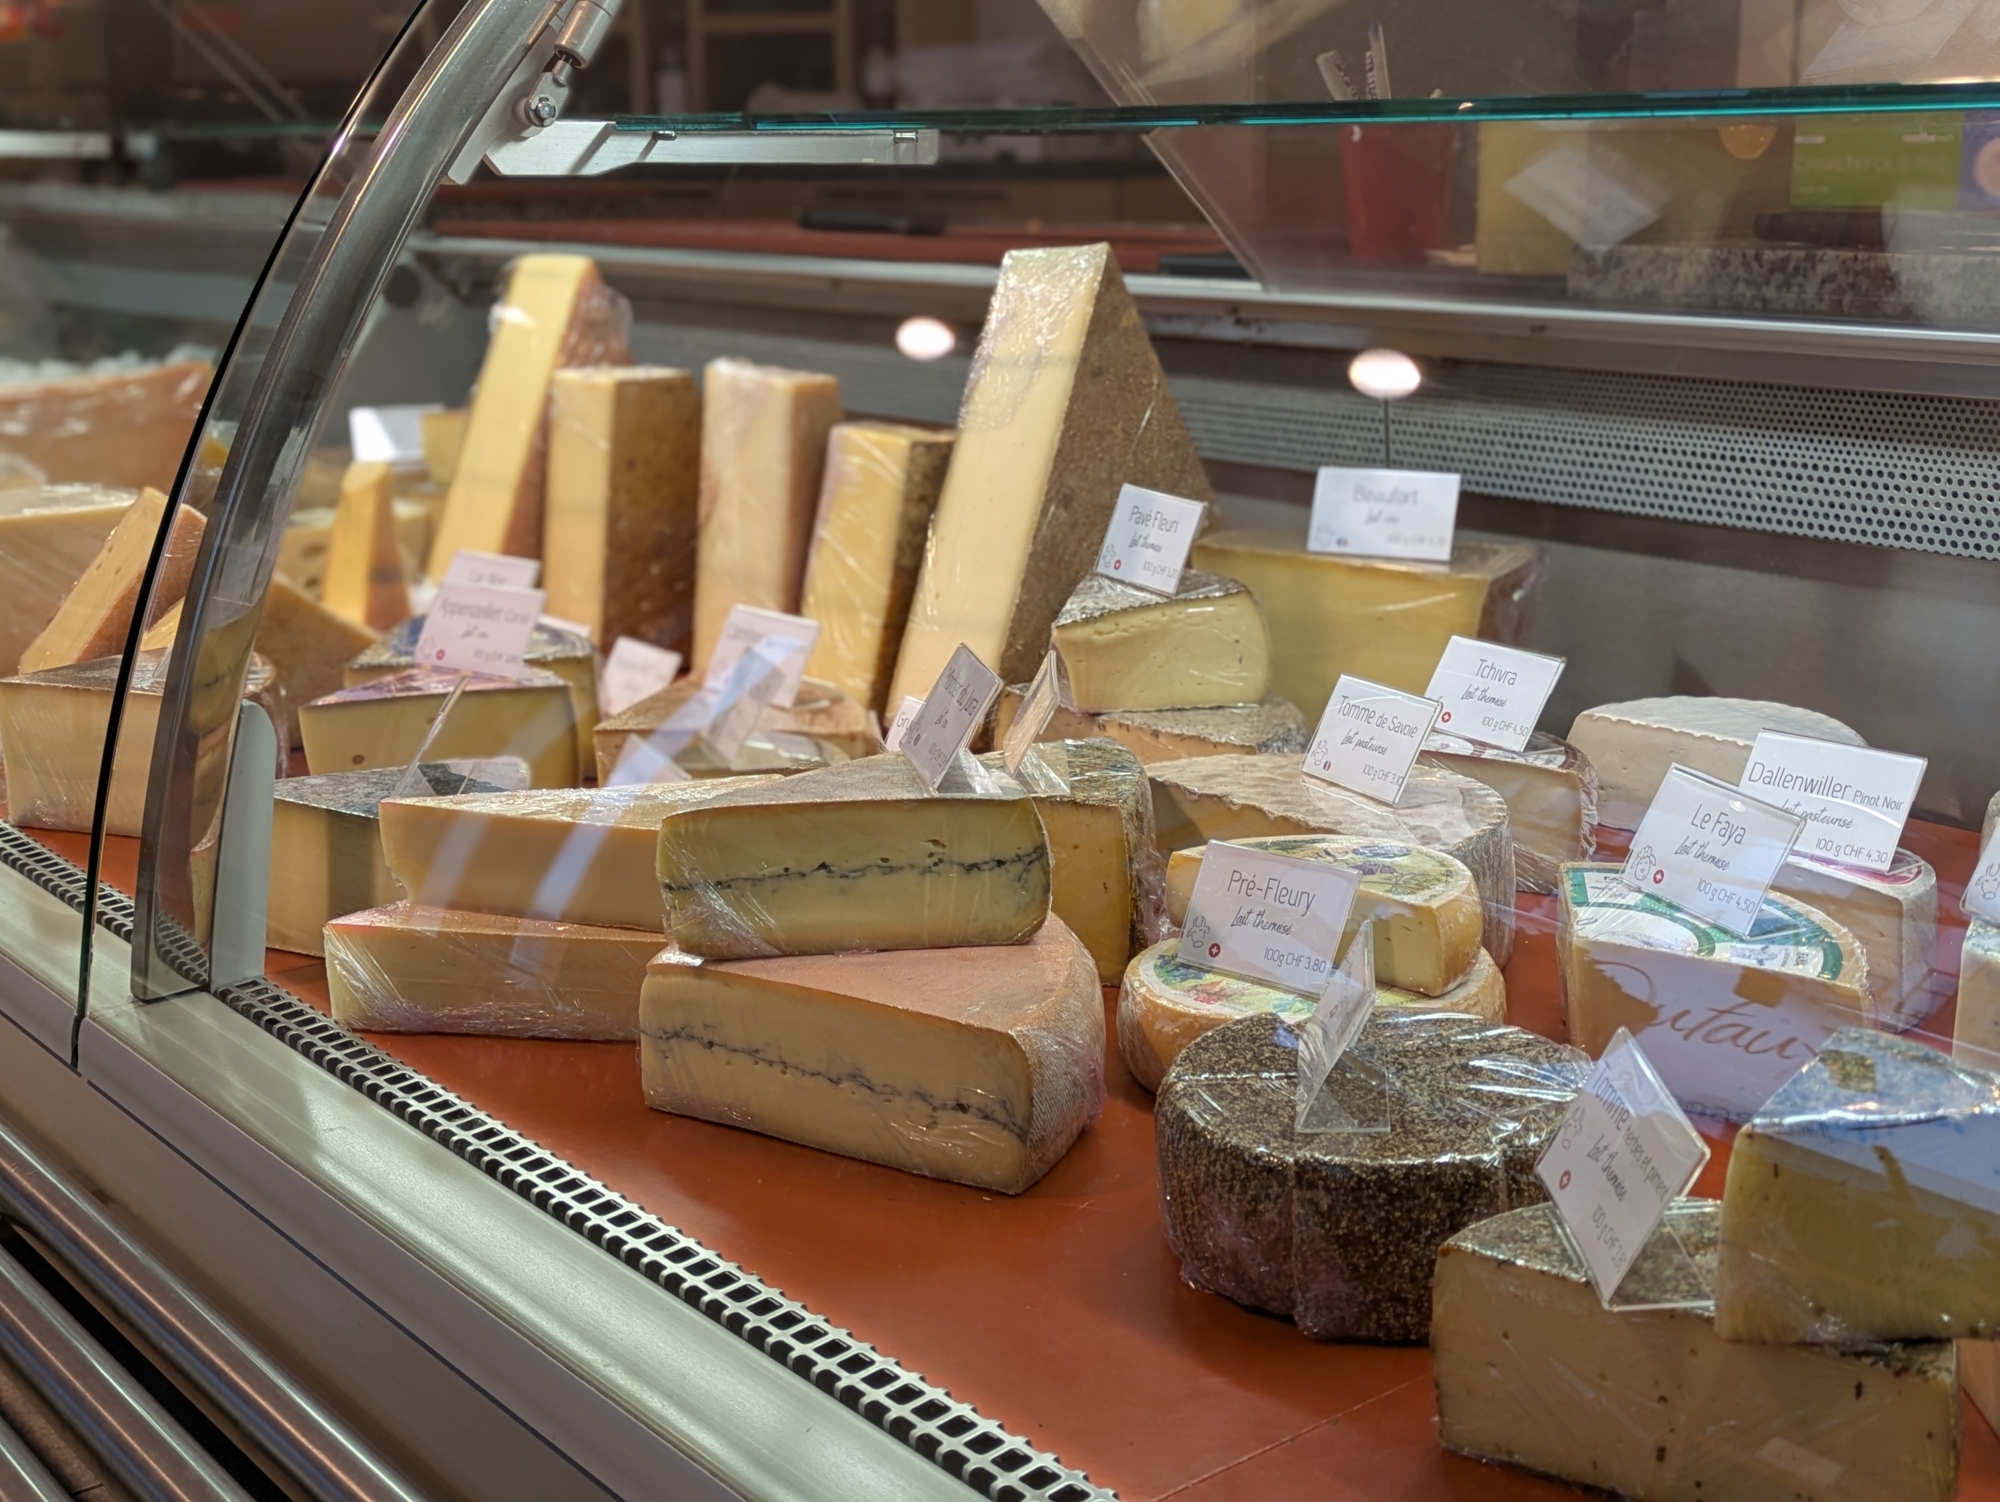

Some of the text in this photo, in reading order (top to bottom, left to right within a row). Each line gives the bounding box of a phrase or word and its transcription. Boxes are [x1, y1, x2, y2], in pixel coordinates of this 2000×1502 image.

[1128, 505, 1153, 527] Pavé
[1476, 658, 1518, 686] Tchivra
[1338, 695, 1418, 738] Tomme de Savoie
[1481, 715, 1495, 727] 100
[1491, 721, 1498, 731] g
[1498, 720, 1514, 732] CHF
[1362, 763, 1374, 776] 100
[1377, 769, 1392, 782] CHF
[1748, 762, 1905, 812] Dallenwiller Pinot Noir
[1691, 804, 1747, 847] Le Faya
[1674, 835, 1698, 856] Lait
[1815, 837, 1834, 851] 100
[1834, 845, 1842, 857] g
[1844, 844, 1865, 858] CHF
[1227, 869, 1316, 917] Pré-Fleury
[1696, 878, 1712, 895] 100
[1709, 888, 1718, 901] g
[1718, 888, 1736, 904] CHF
[1230, 906, 1254, 928] Lait
[1286, 954, 1304, 969] CHF
[1592, 1060, 1669, 1203] Tomme herbes et piment
